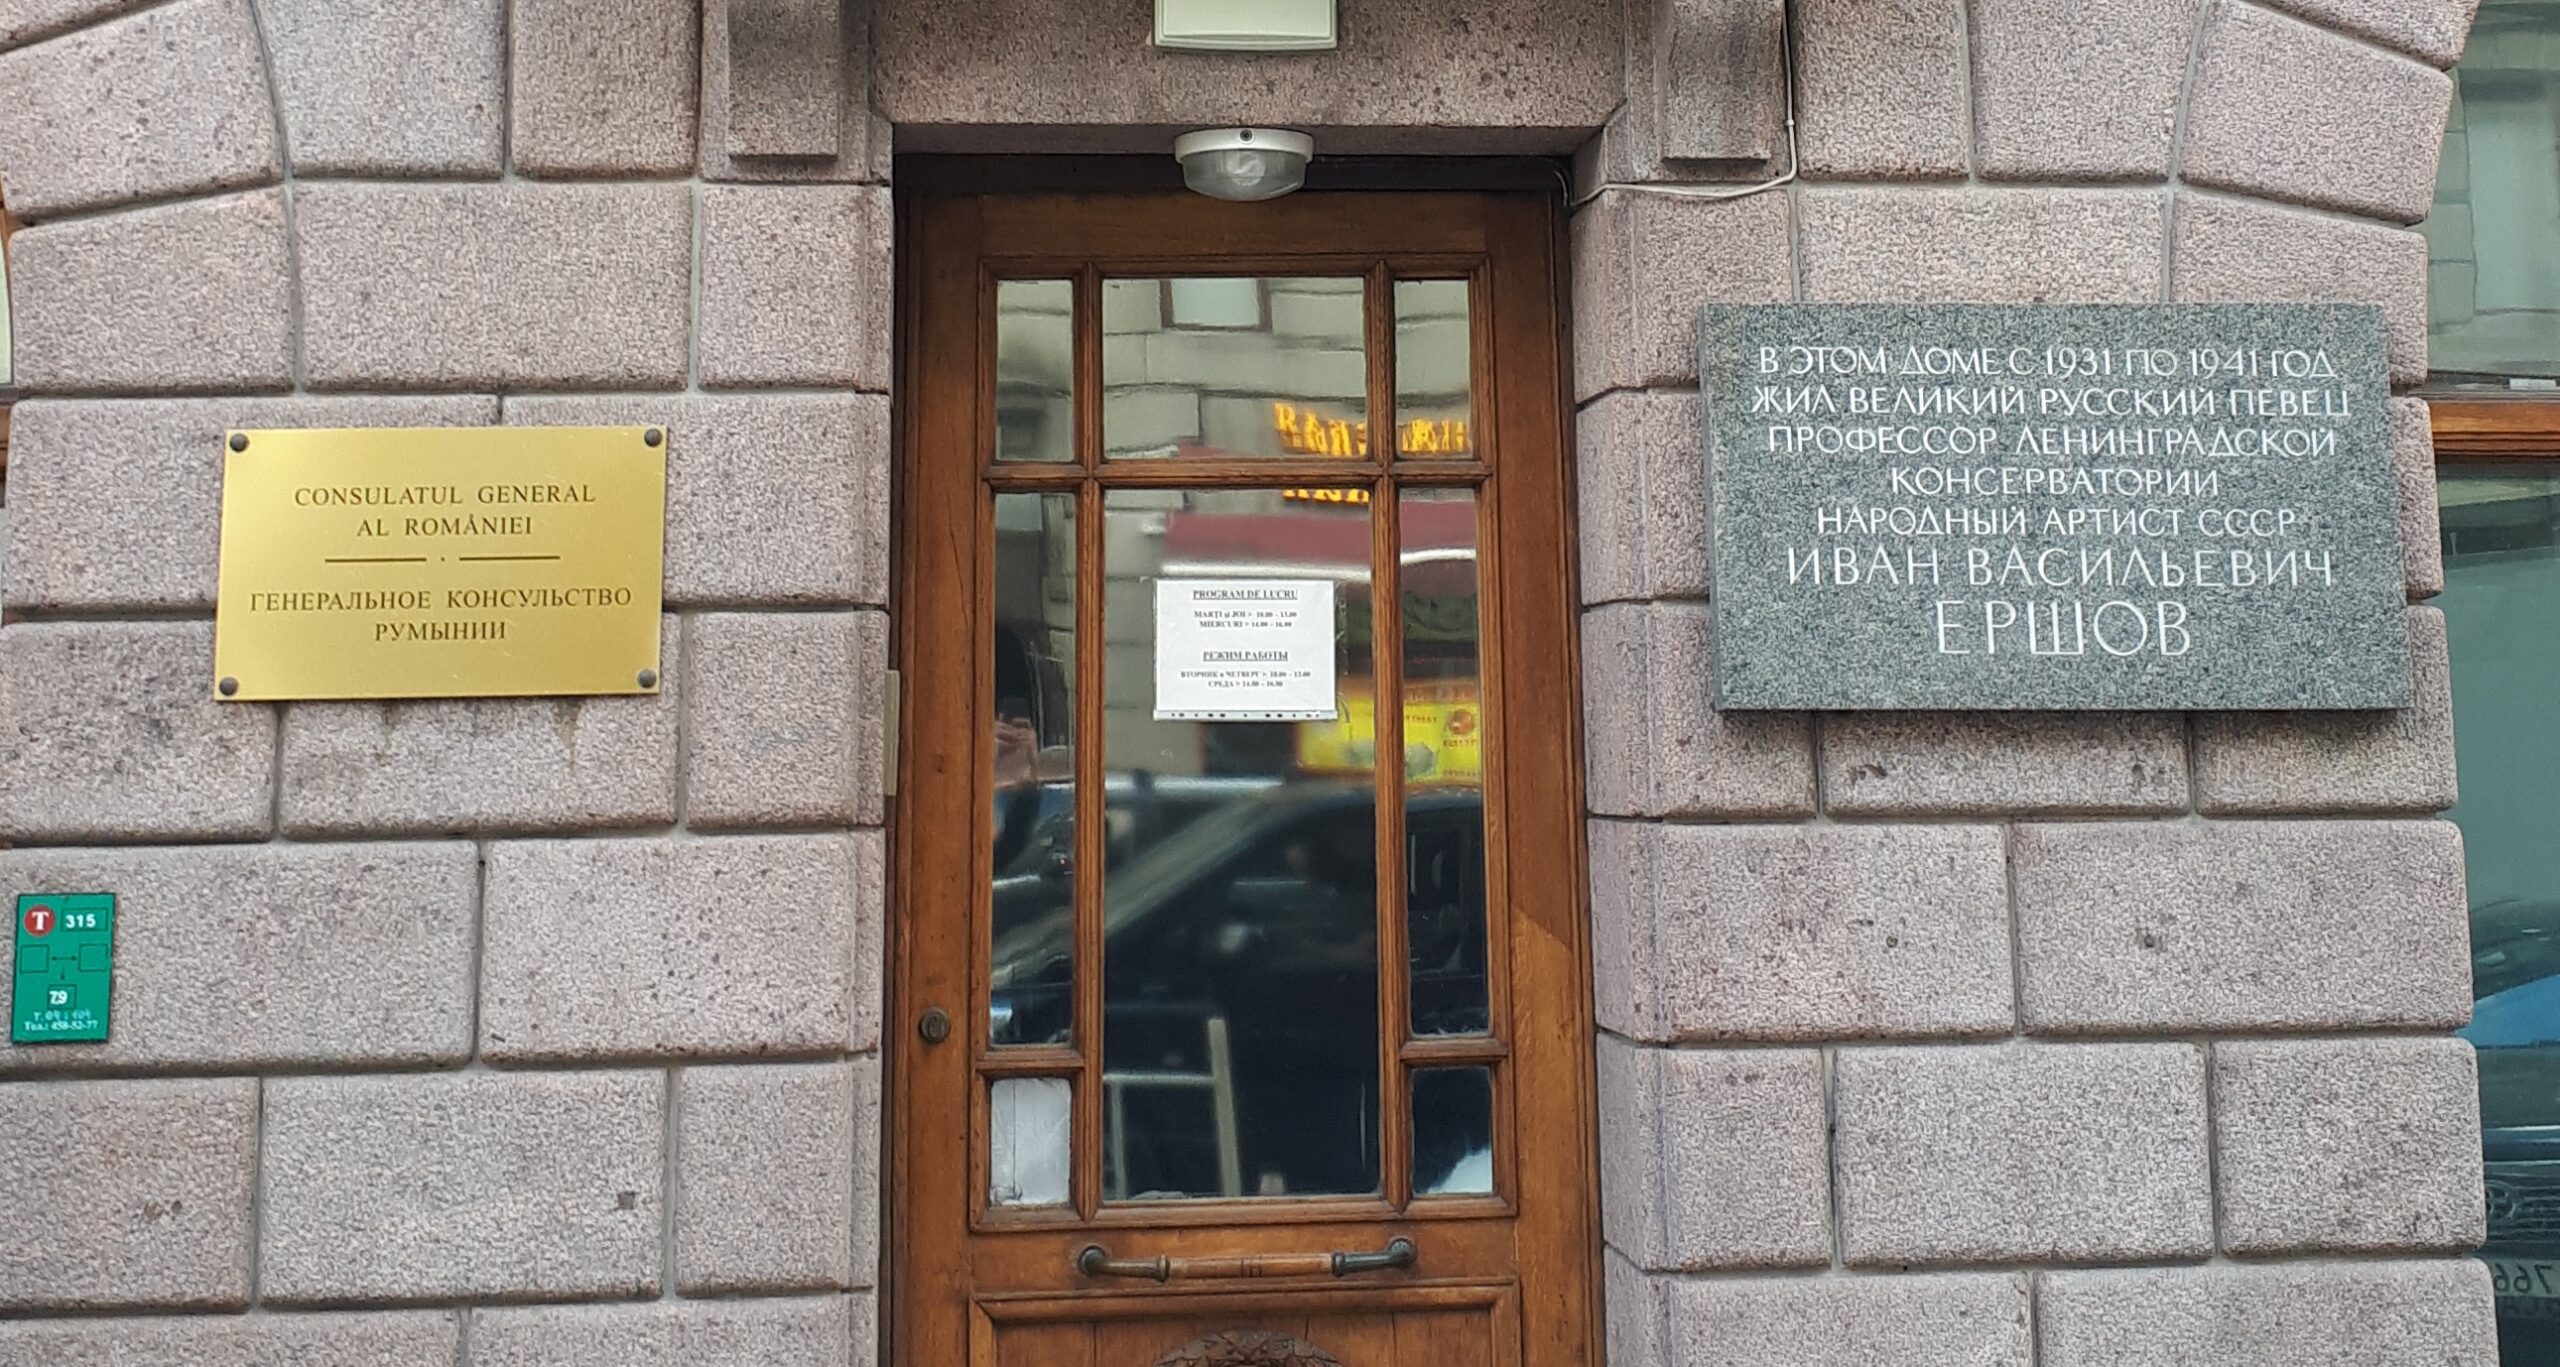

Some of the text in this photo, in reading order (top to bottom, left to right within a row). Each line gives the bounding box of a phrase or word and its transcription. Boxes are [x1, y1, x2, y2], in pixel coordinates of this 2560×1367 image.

[1759, 346, 2338, 379] В ЭТОМ ДОМЕ С 1931 ПО 1941 ГОД
[1751, 384, 2352, 418] ЖИЛ ВЕЛИКИЙ РУССКИЙ ПЕВЕЦ
[1768, 423, 2336, 458] ПРОФЕССОР ЛЕНИНГРАДСКОЙ
[1891, 465, 2219, 497] КОНСЕРВАТОРИИ
[294, 485, 596, 506] CONSULATUL GENERAL
[356, 518, 390, 537] AL
[1817, 505, 2298, 538] НАРОДНЫЙ АРТИСТ СССР
[1788, 545, 2336, 588] ИВАН ВАСИЛЬЕВИЧ
[250, 587, 633, 611] ГЕНЕРАЛЬНОЕ КОНСУЛЬСТВО
[1193, 589, 1298, 600] PROGRAM DE LUCRU
[374, 621, 507, 642] РУМЫНИИ
[1199, 620, 1243, 628] MIERCURI
[1936, 600, 2194, 656] ЕРШОВ
[1203, 651, 1288, 662] РЕЖИМ РАБОТЫ
[65, 913, 96, 929] 315
